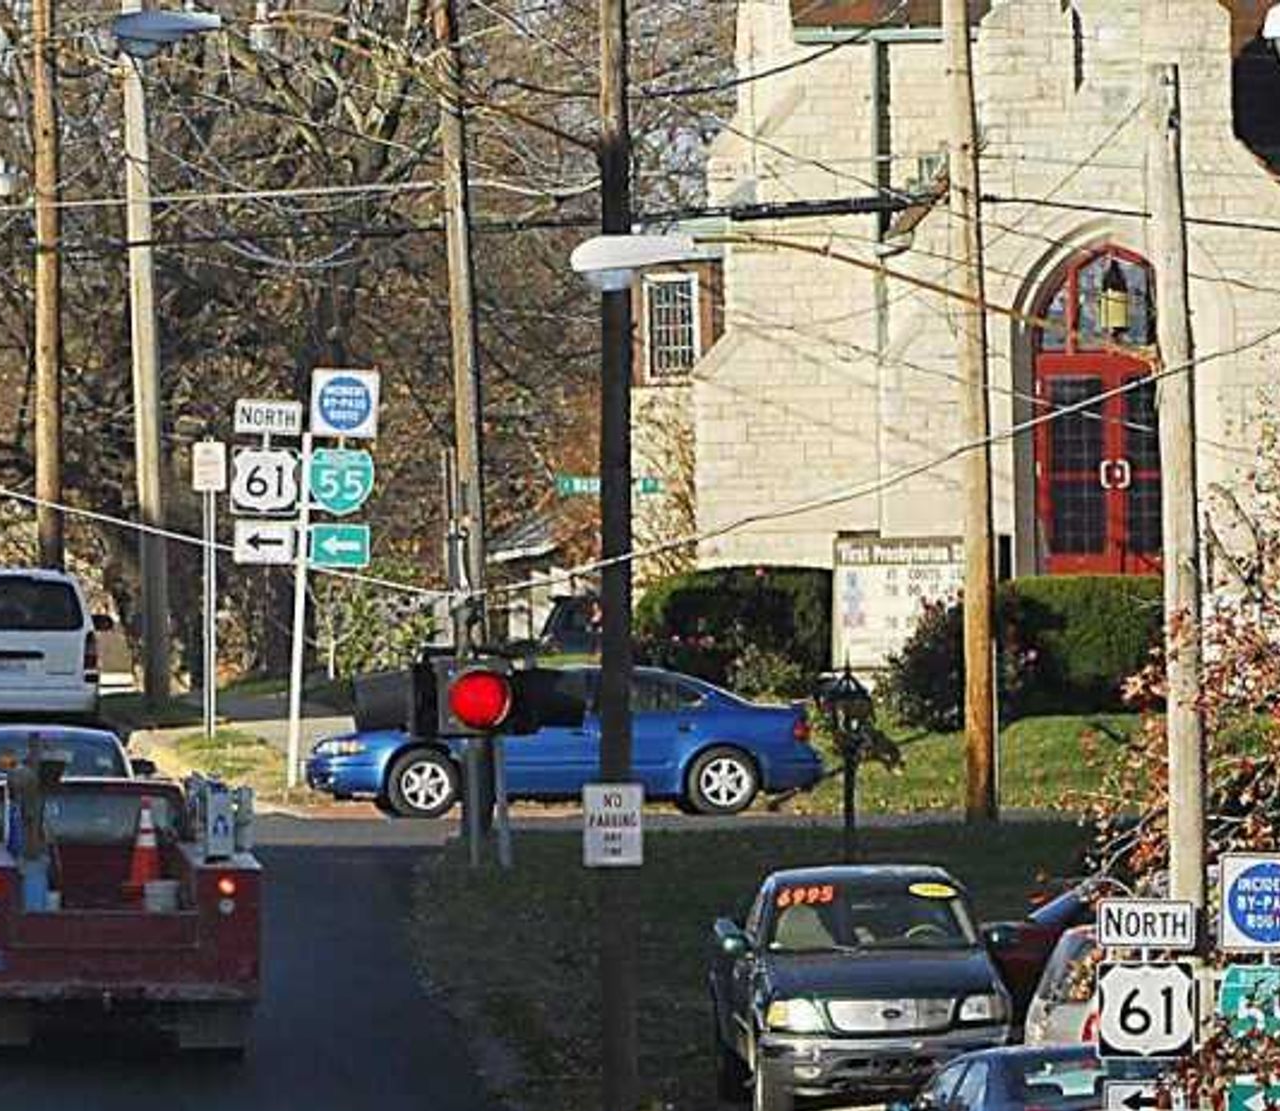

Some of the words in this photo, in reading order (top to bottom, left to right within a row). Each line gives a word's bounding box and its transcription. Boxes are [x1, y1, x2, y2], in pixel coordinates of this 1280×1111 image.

[239, 407, 296, 427] NORTH
[246, 464, 283, 498] 61
[320, 469, 363, 500] 55
[603, 793, 622, 808] NO
[589, 810, 638, 828] PARKING
[1104, 907, 1188, 938] NORTH
[1120, 985, 1173, 1036] 61
